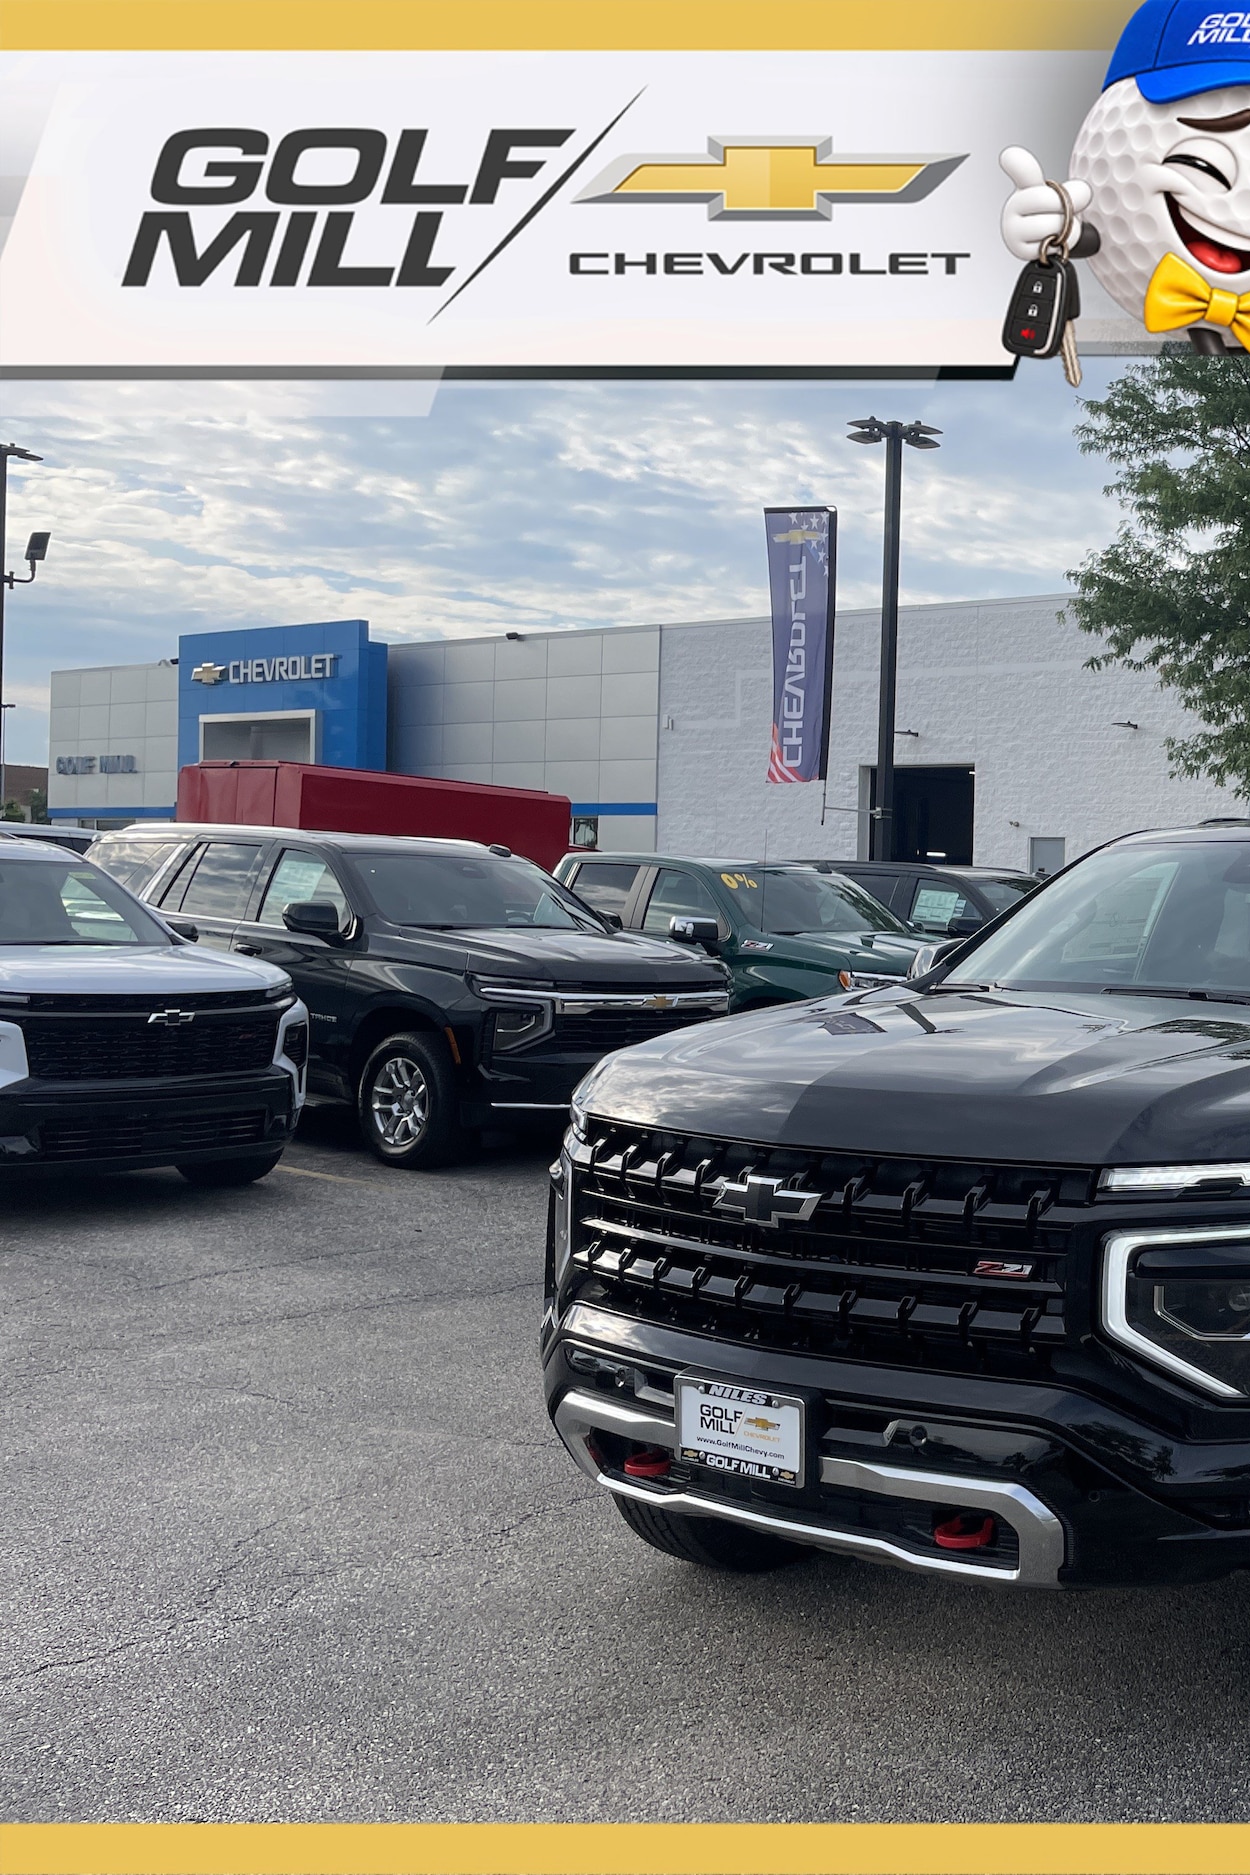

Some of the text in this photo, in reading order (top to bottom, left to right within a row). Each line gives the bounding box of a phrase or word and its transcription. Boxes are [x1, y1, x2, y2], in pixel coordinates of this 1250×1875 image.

[229, 653, 335, 684] CHEVROLET
[782, 554, 807, 768] CHEVROLET
[720, 872, 758, 890] 0%
[973, 1260, 1033, 1278] Z71
[708, 1384, 768, 1406] NILES
[700, 1403, 743, 1423] GOLF
[700, 1416, 735, 1435] MILL
[696, 1434, 785, 1460] www.GolfMillChevy.com
[743, 1430, 780, 1443] CHEVROLET
[706, 1453, 771, 1479] GOLF MILL
